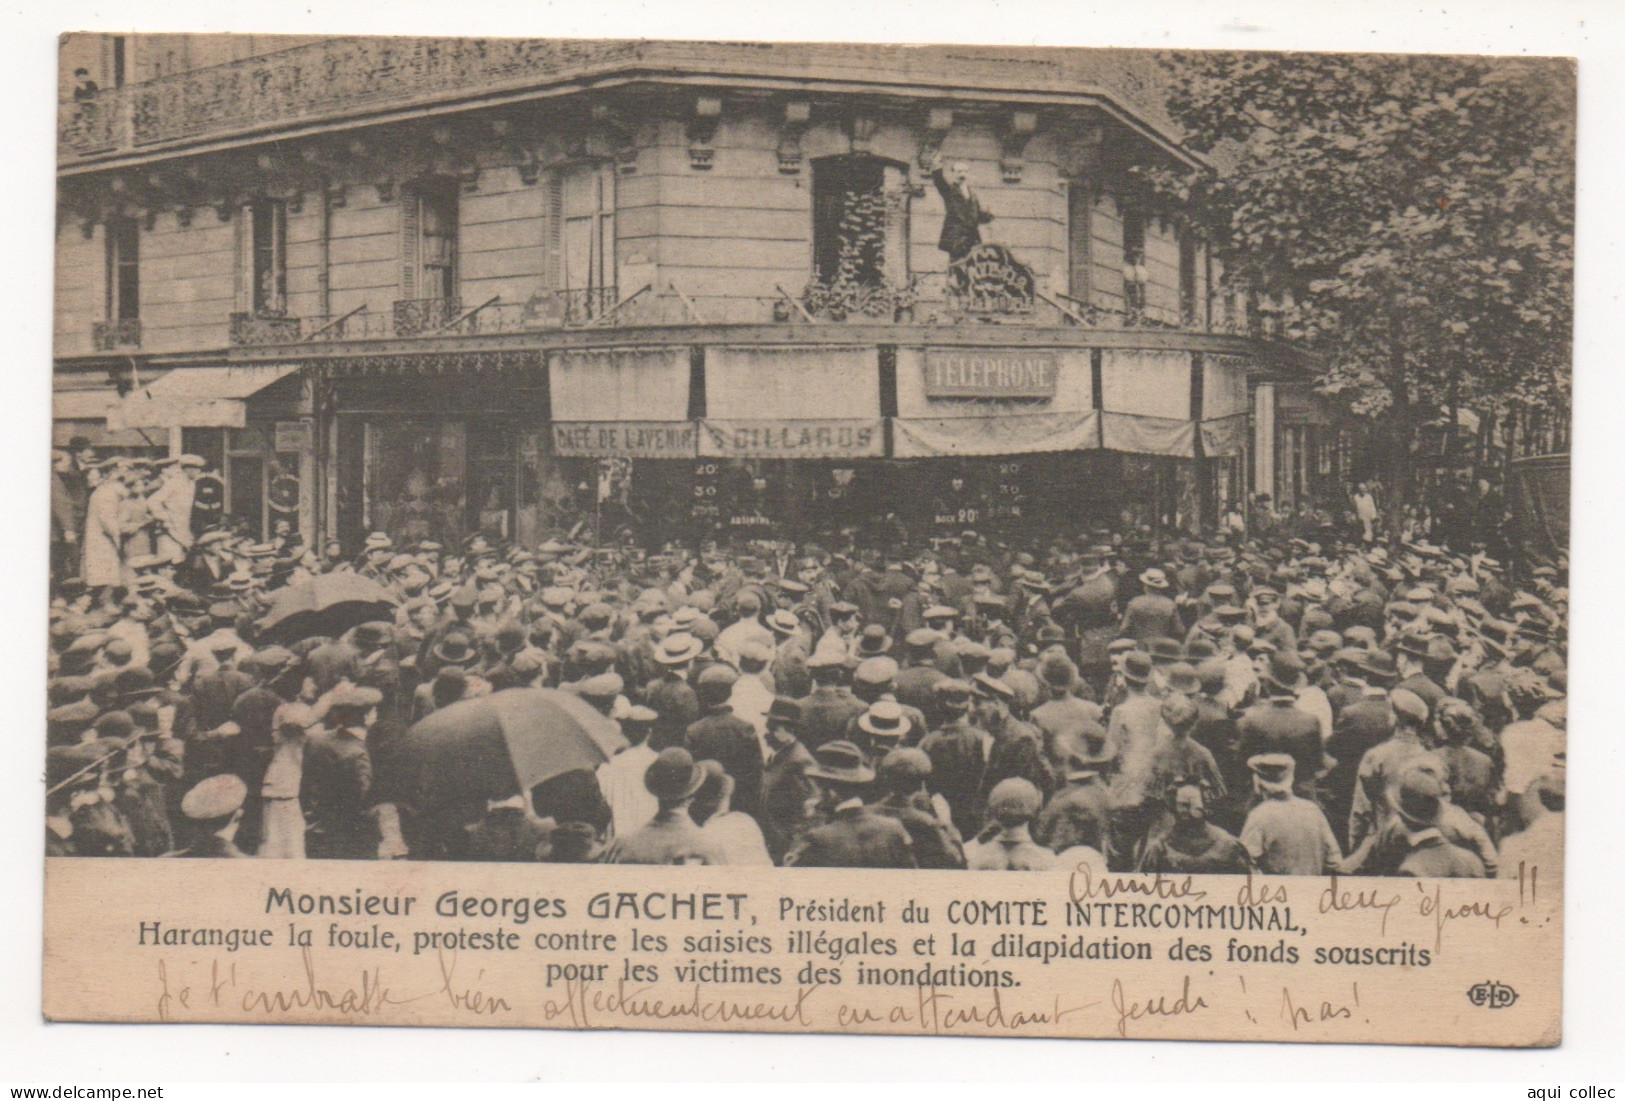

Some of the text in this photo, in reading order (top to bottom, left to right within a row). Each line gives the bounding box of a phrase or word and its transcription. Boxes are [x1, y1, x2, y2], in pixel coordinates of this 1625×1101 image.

[599, 428, 618, 449] DE
[266, 888, 416, 916] Monsieur
[436, 891, 567, 925] Georges
[587, 892, 758, 926] GACHET,
[779, 897, 886, 923] Président
[902, 900, 930, 923] du
[1066, 901, 1308, 937] INTERCOMMUNAL,
[138, 922, 1431, 967] Harangue la foule, proteste contre les saisies illégales et la dilapidation des fonds souscrits
[546, 959, 1022, 988] pour les victimes des inondations.
